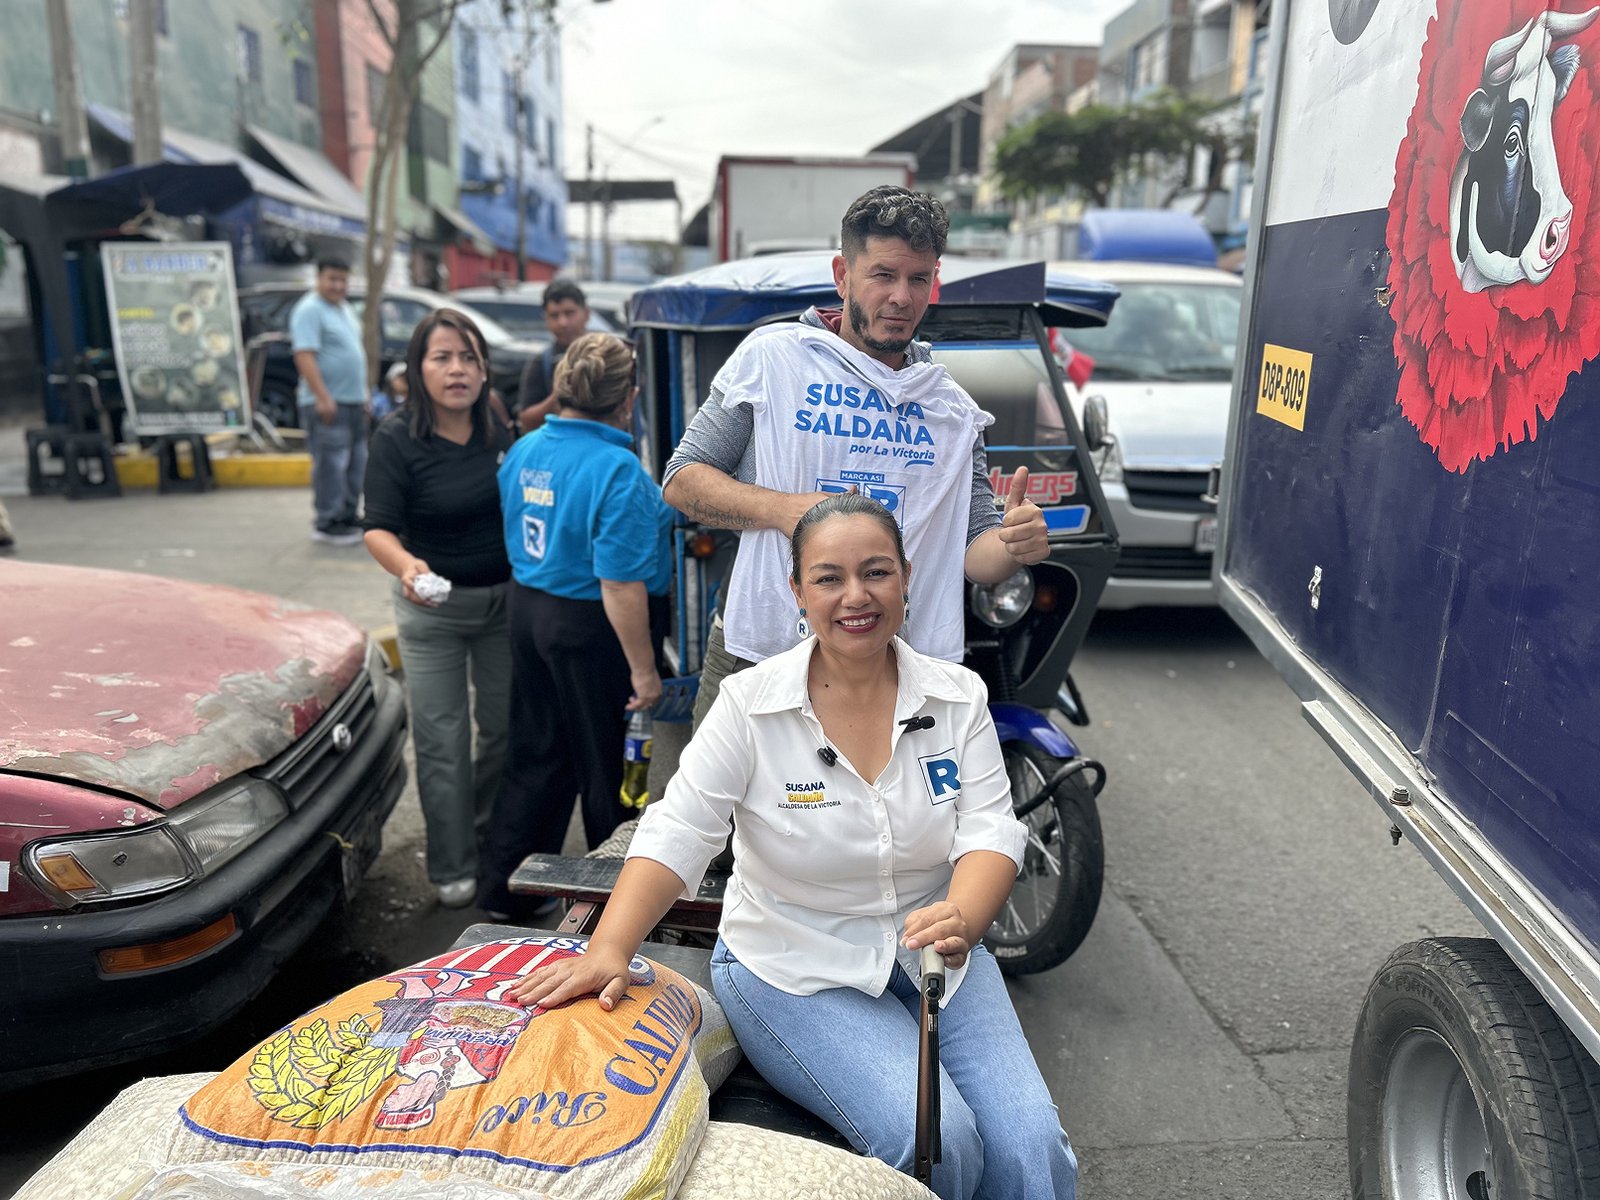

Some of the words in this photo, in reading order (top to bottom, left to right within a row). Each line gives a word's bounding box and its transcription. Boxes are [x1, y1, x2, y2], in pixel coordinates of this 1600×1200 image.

[1262, 361, 1305, 412] D8P-809
[794, 409, 935, 446] SALDAÑA
[850, 443, 871, 454] por
[873, 445, 889, 455] La
[892, 447, 935, 459] Victoria
[841, 471, 868, 481] MARCA
[799, 623, 806, 634] R
[926, 758, 961, 797] R
[785, 781, 825, 792] SUSANA
[818, 800, 841, 809] VICTORIA
[425, 1028, 516, 1047] PREMIUM
[469, 1091, 607, 1140] Rice
